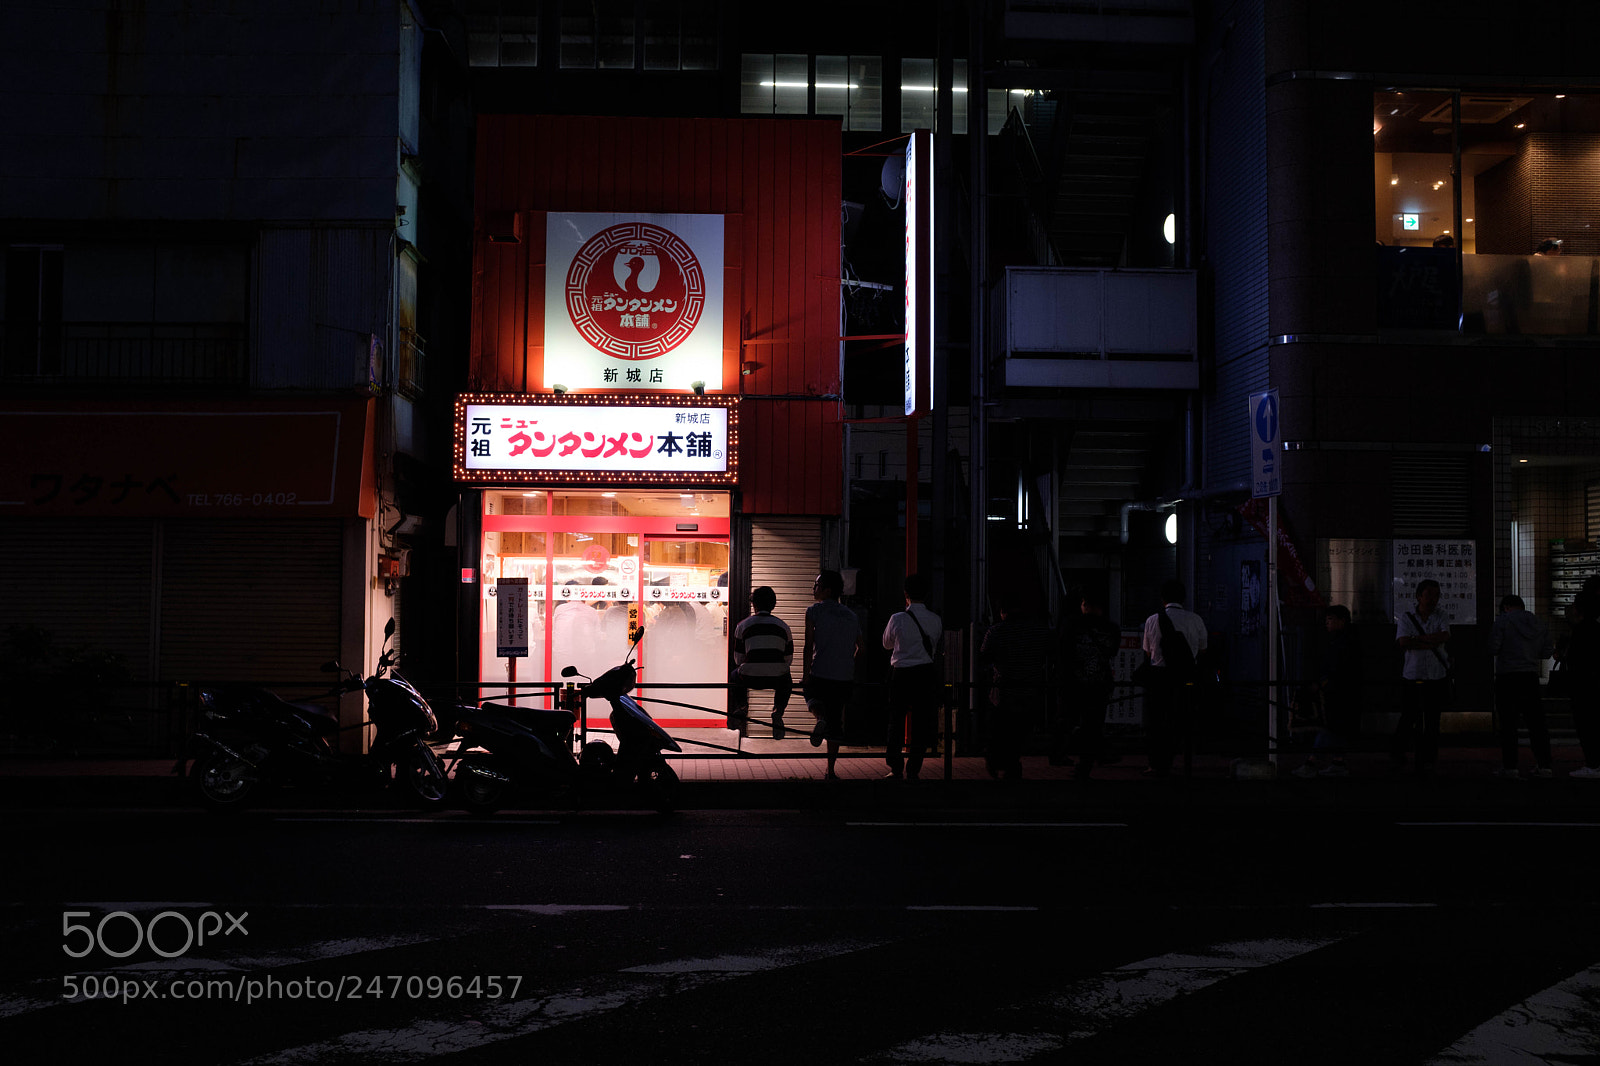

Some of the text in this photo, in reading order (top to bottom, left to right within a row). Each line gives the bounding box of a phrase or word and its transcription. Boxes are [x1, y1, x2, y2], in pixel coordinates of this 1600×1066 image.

[591, 296, 603, 312] 元祖
[603, 298, 678, 313] タンタンメン
[619, 313, 651, 328] 本舗
[603, 367, 664, 383] 新城店
[500, 417, 539, 428] ニュー
[675, 412, 711, 424] 新城店
[471, 417, 491, 457] 元祖
[31, 474, 181, 505] ワタナベ
[1397, 543, 1473, 556] 池田歯科医院
